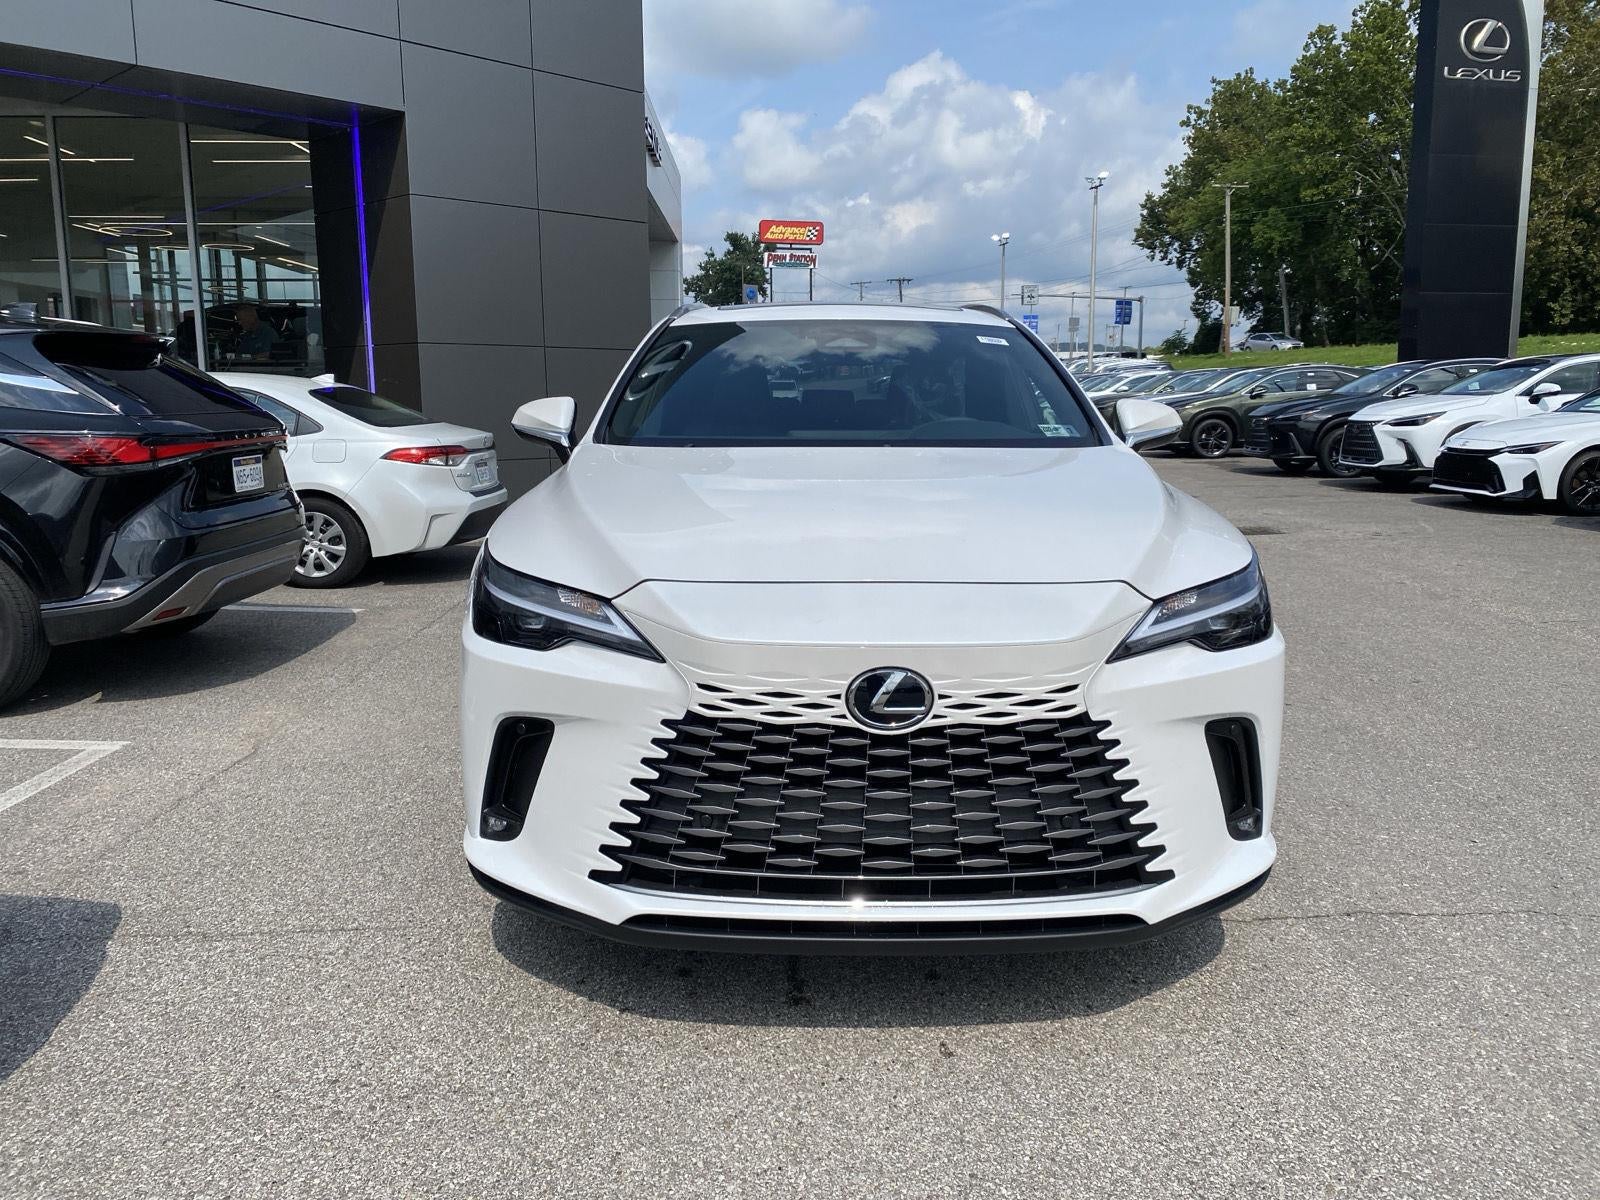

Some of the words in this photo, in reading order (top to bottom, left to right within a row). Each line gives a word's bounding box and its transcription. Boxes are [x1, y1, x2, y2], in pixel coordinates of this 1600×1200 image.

[1443, 66, 1521, 82] LEXUS
[768, 225, 806, 234] Advance
[783, 232, 805, 240] Parts
[767, 253, 788, 268] PENN
[789, 253, 817, 268] STATION
